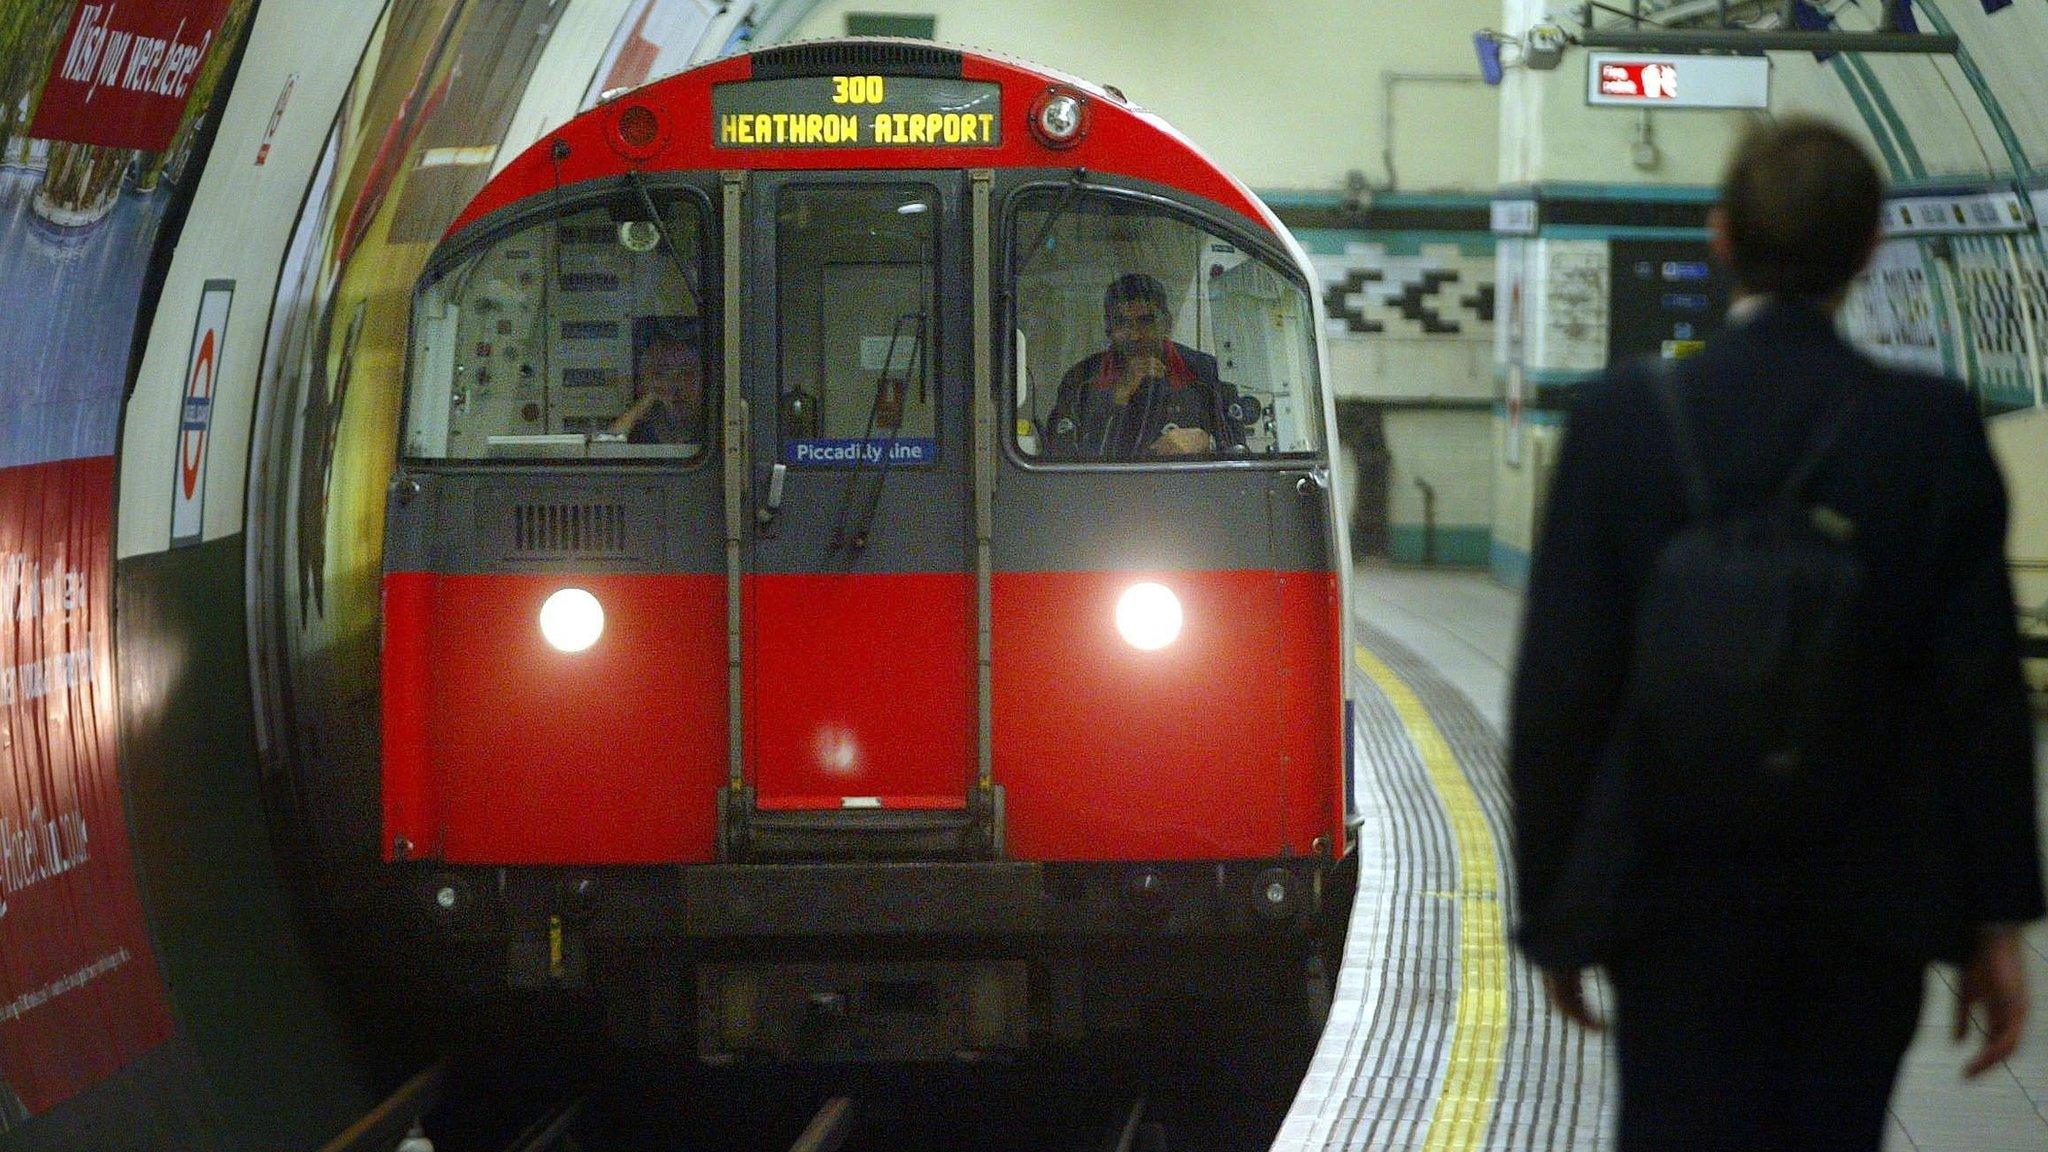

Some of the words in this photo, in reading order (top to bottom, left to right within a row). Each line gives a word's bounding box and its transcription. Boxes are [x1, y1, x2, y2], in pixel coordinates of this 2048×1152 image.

[61, 3, 115, 82] Wish
[86, 31, 133, 103] you
[122, 35, 167, 92] were
[151, 17, 212, 98] here?
[832, 76, 884, 103] 300
[721, 114, 857, 142] HEATHROW
[875, 114, 993, 142] AIRPORT
[797, 442, 882, 462] Piccadily
